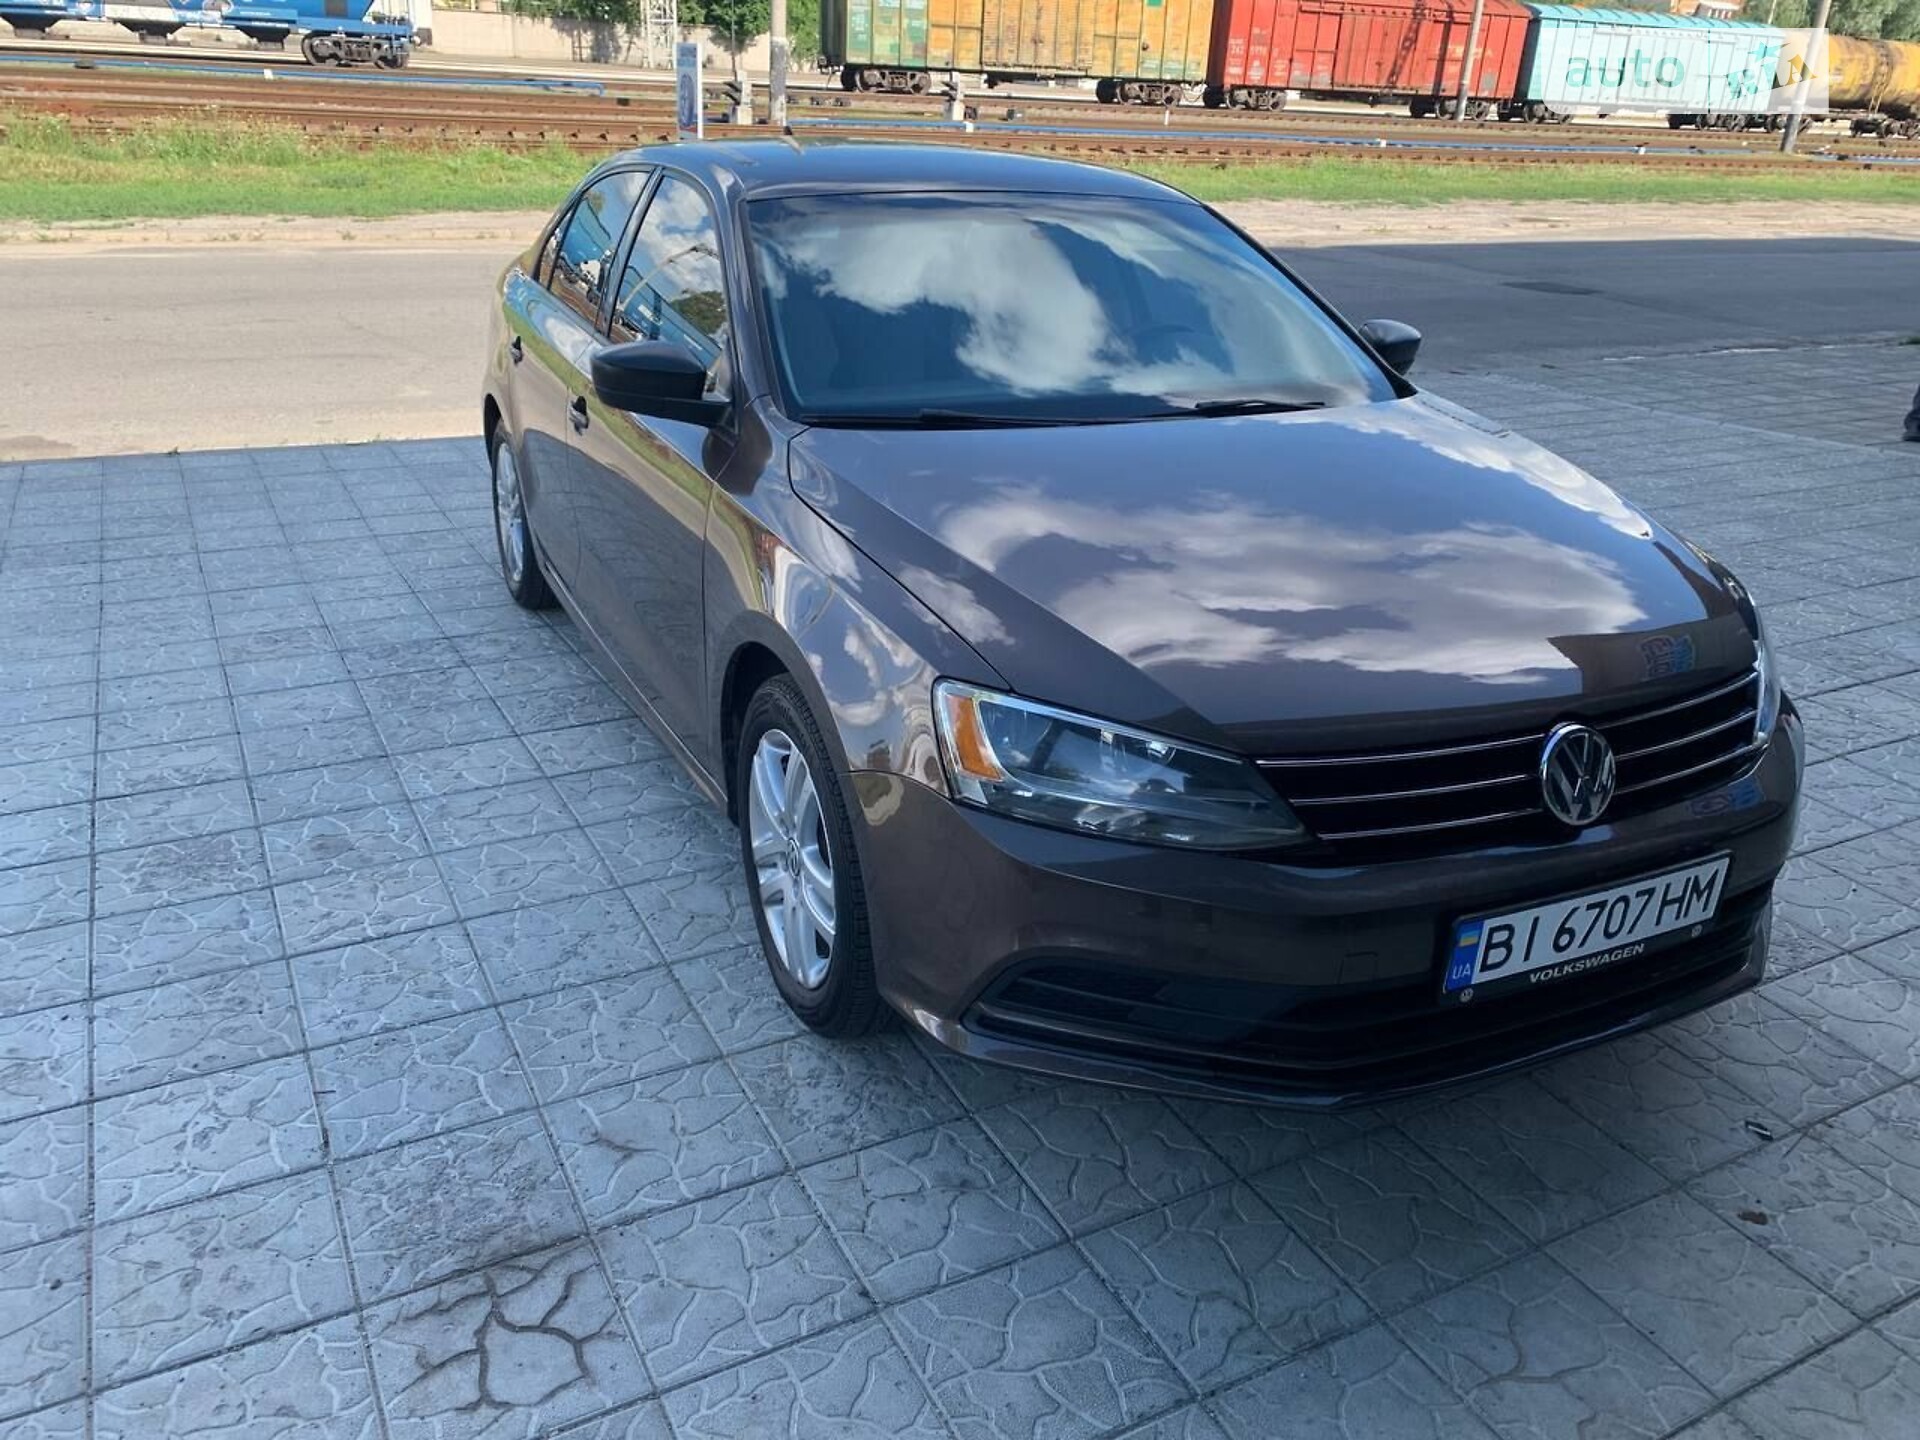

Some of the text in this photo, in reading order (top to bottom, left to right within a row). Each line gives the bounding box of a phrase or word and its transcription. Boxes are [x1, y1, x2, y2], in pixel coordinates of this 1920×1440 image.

[1479, 868, 1720, 974] BI 6707 HM
[1452, 963, 1471, 980] UA
[1529, 943, 1645, 983] VOLKSWAGEN
